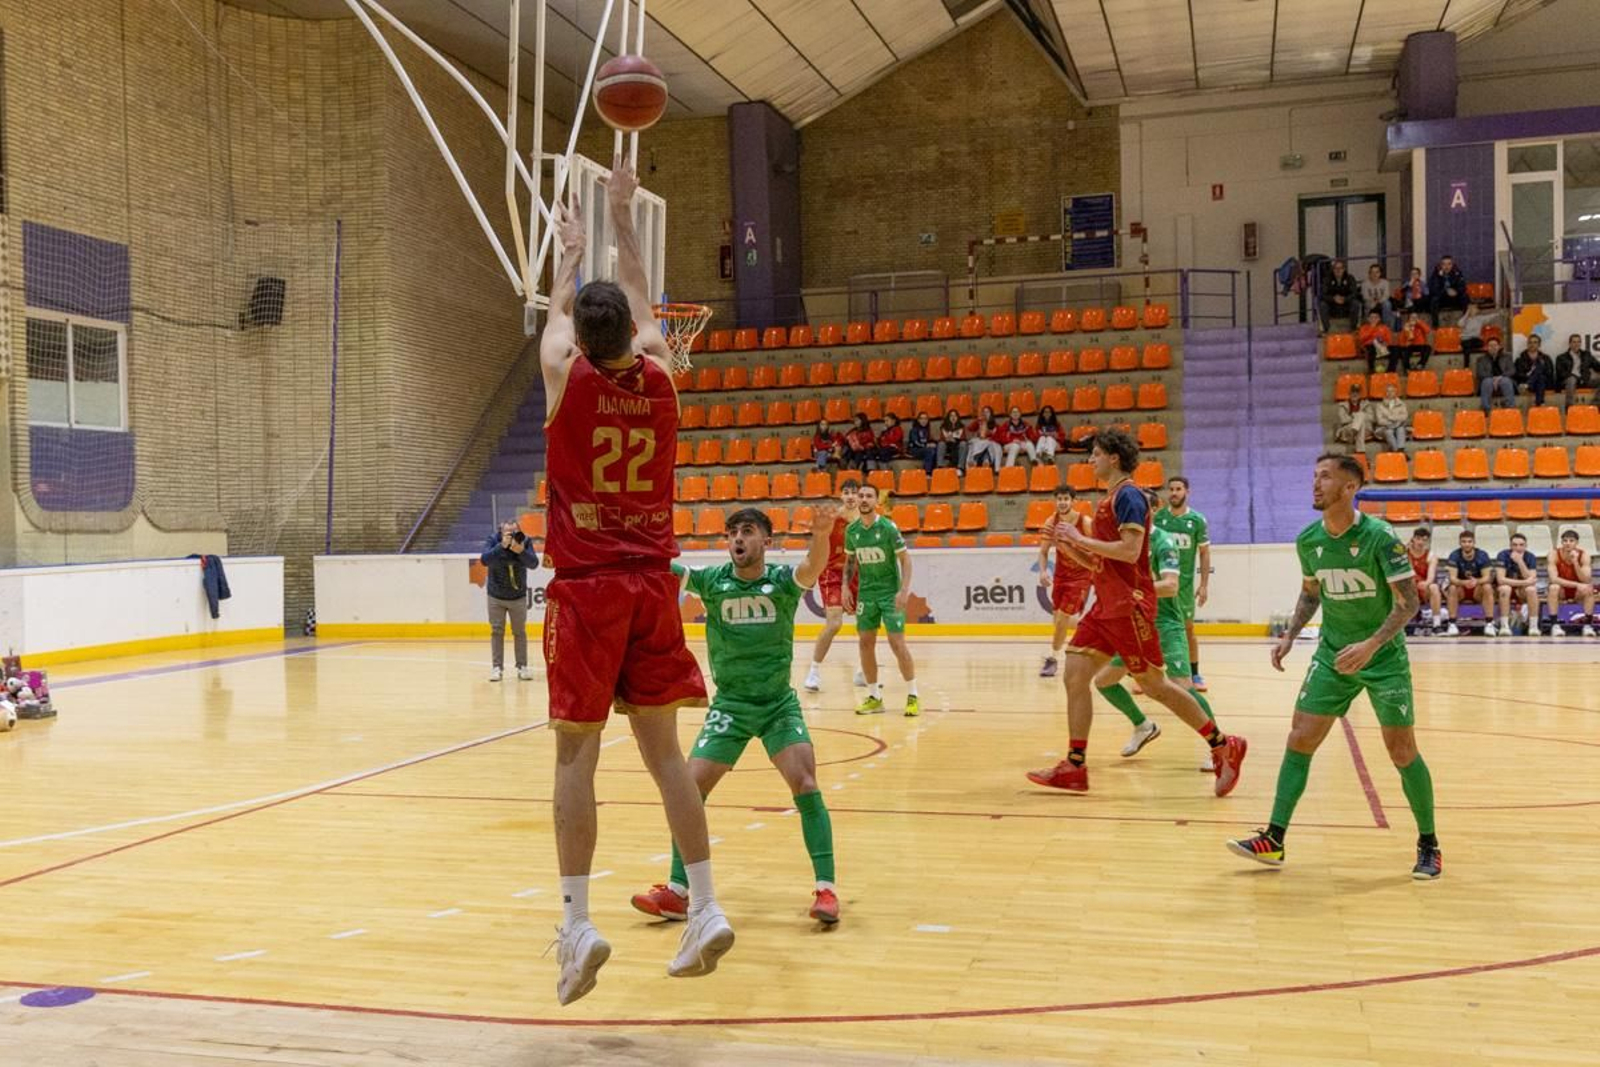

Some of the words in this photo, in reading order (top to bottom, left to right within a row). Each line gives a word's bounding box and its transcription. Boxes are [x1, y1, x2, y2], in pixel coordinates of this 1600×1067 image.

[1451, 188, 1467, 208] A
[744, 226, 757, 244] A
[596, 394, 651, 416] JUANMA
[592, 426, 656, 493] 22
[963, 577, 1025, 611] jaén
[704, 709, 734, 734] 23
